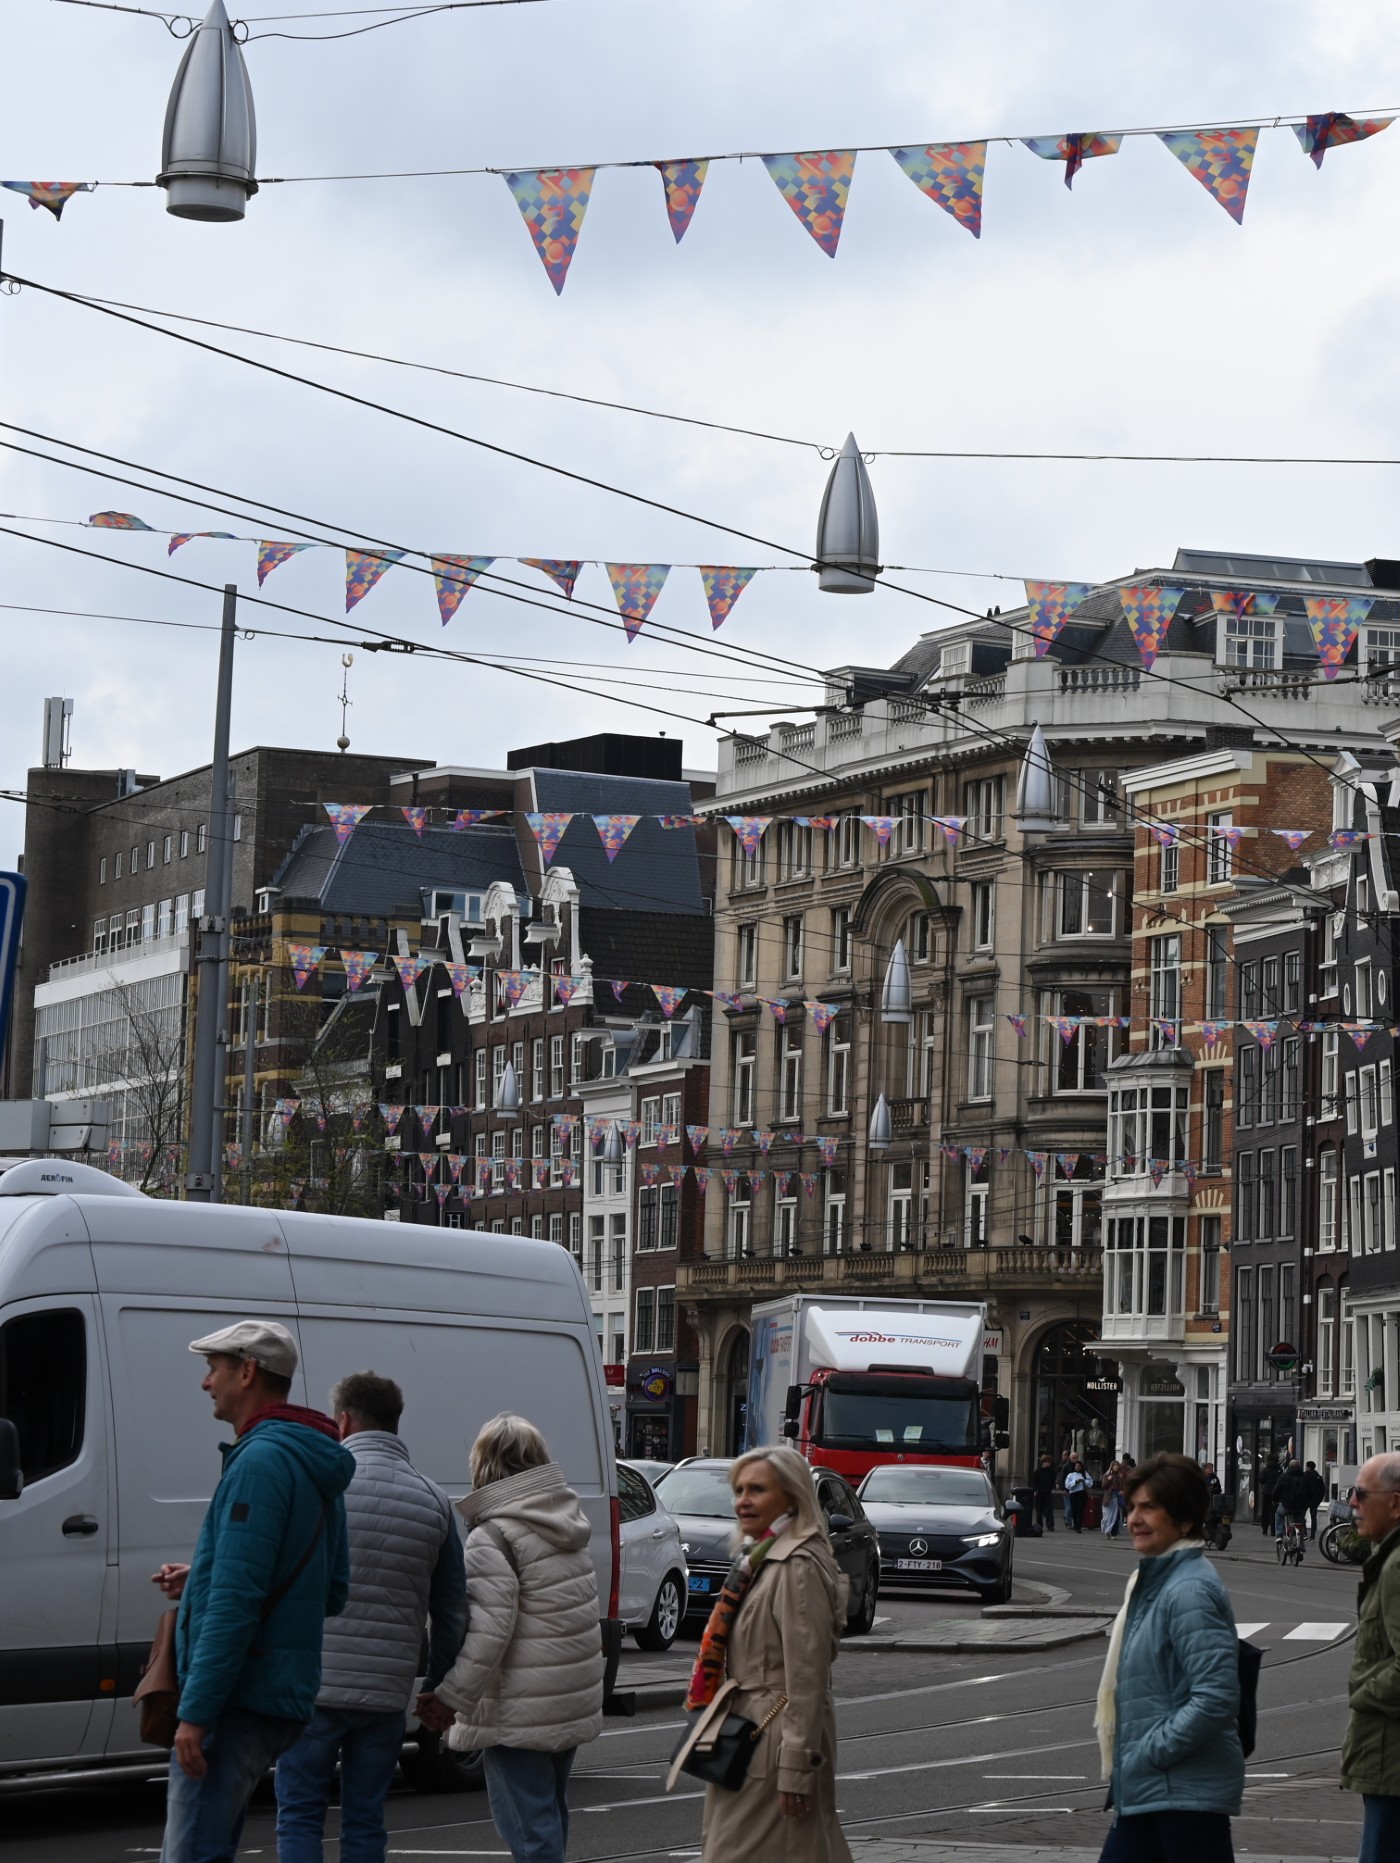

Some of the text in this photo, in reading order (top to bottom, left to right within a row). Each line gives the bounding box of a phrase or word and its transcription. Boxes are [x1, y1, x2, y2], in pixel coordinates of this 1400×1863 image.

[850, 1332, 961, 1349] dobbe TRANSPORT
[1087, 1381, 1118, 1391] HOLLISTER
